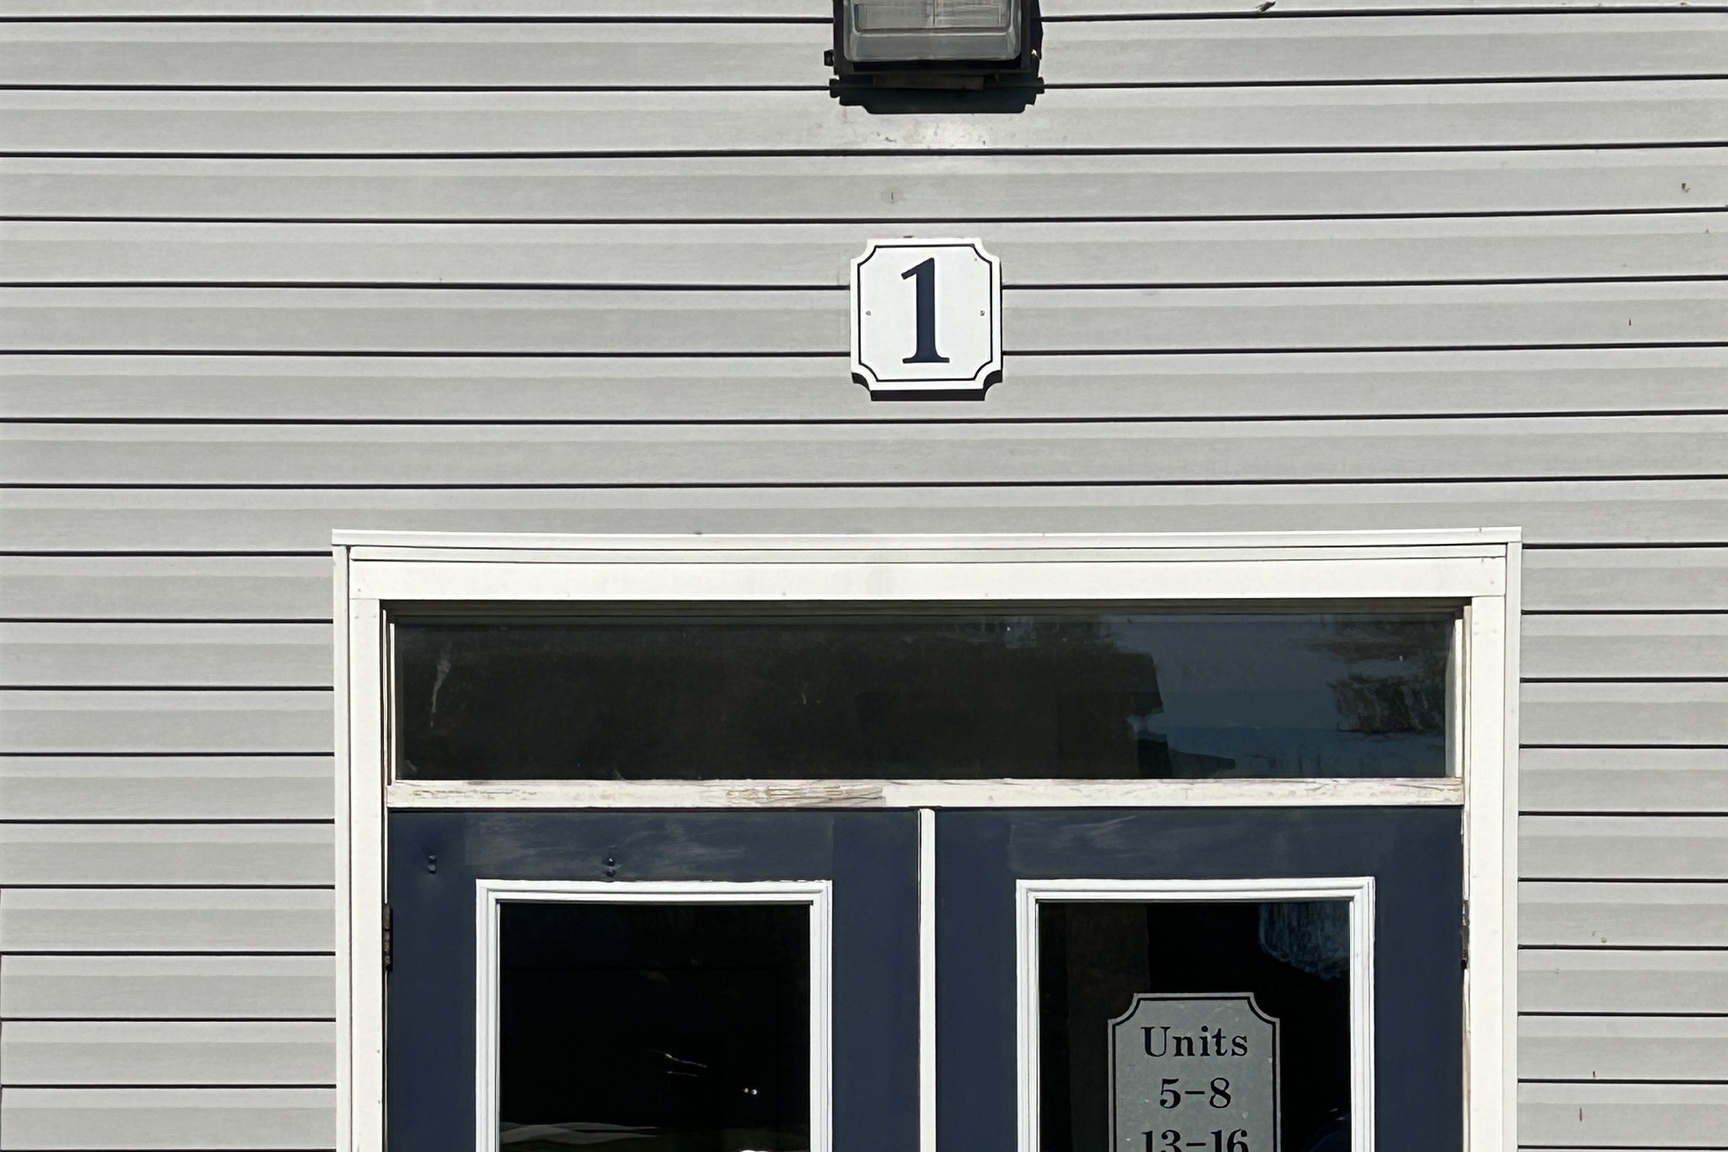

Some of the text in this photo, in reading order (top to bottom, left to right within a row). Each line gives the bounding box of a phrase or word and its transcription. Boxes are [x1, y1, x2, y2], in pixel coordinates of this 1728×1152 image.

[901, 257, 950, 364] 1
[1141, 1025, 1248, 1057] Units
[1159, 1077, 1232, 1109] 5-8
